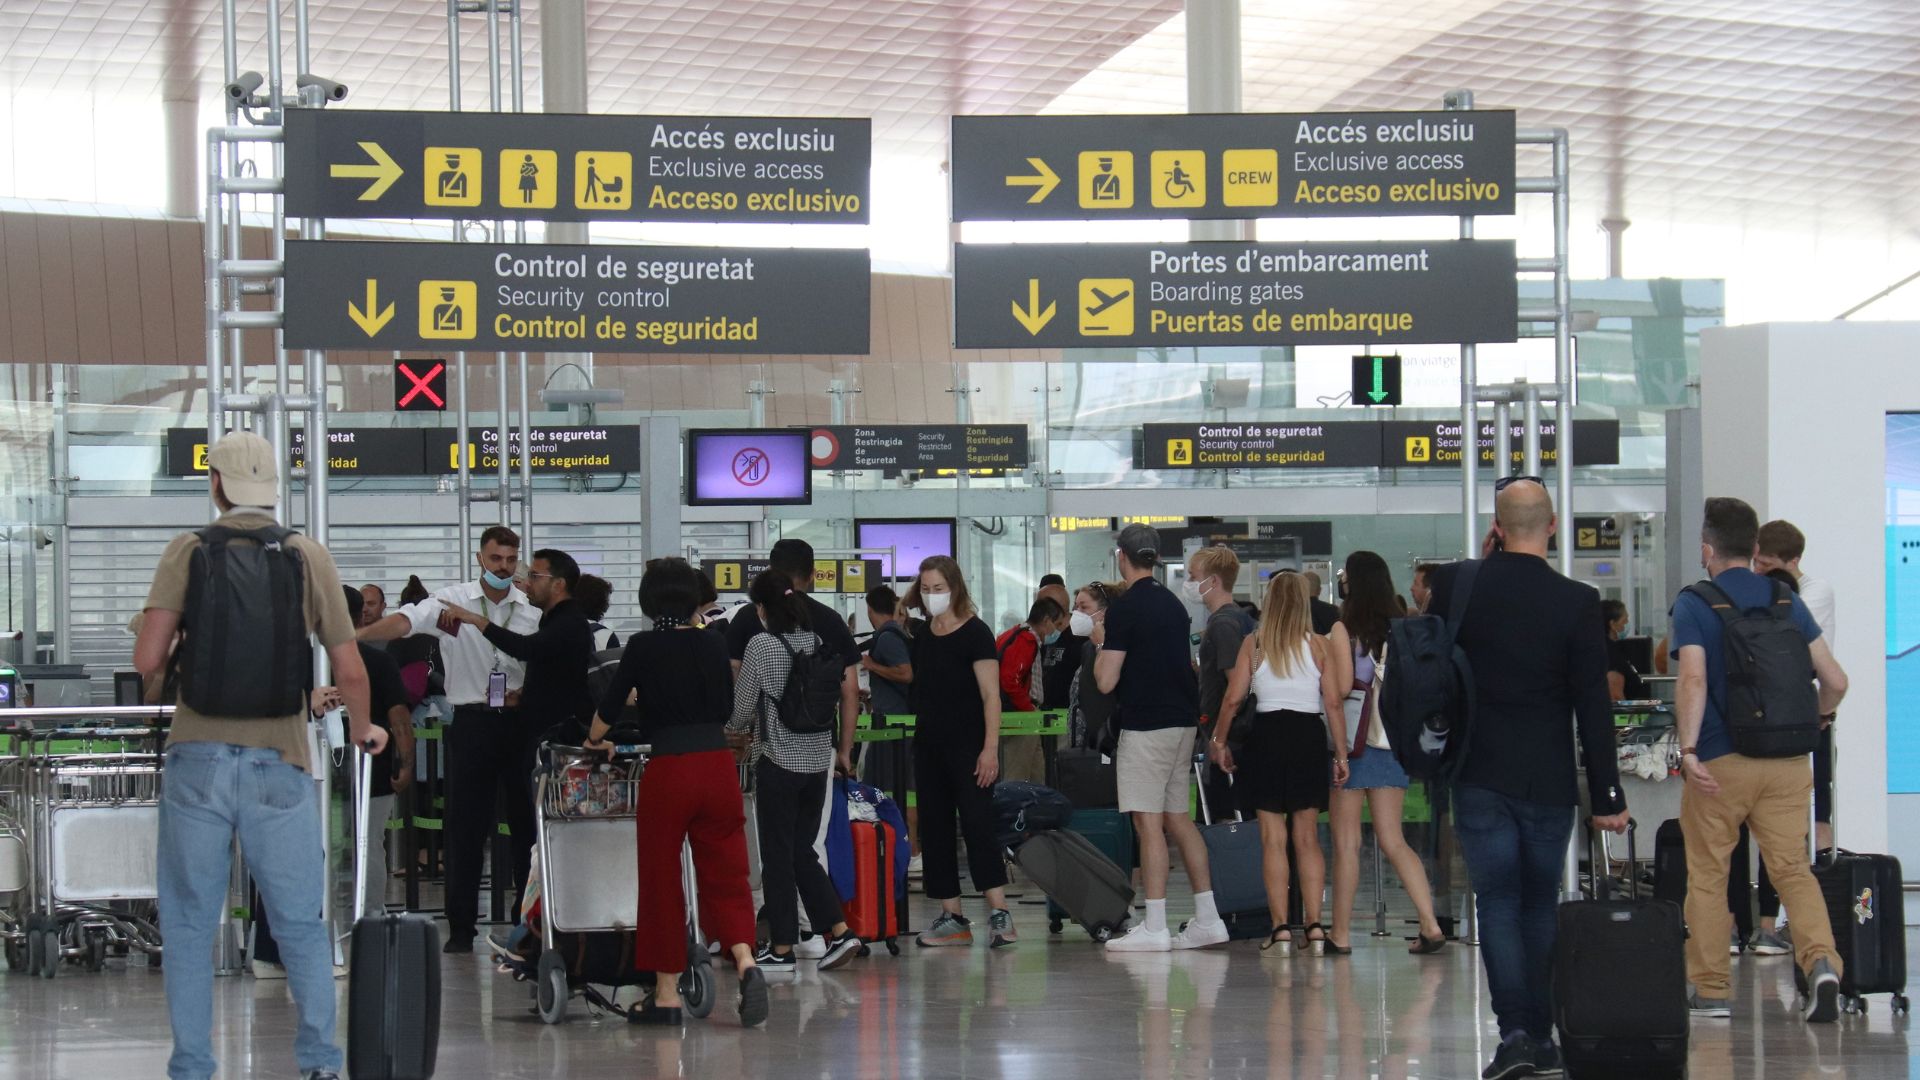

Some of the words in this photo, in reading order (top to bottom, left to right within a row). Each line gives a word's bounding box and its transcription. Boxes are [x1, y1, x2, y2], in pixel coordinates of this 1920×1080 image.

[650, 123, 725, 150] Accés
[734, 127, 836, 152] exclusiu
[1294, 118, 1368, 144] Accés
[1376, 118, 1474, 143] exclusiu
[649, 155, 746, 179] Exclusive
[754, 162, 824, 180] access
[1294, 151, 1389, 172] Exclusive
[1395, 153, 1465, 171] access
[1227, 171, 1272, 185] CREW
[1294, 180, 1381, 204] Acceso
[1389, 177, 1500, 202] exclusivo
[648, 185, 738, 211] Acceso
[746, 187, 861, 213] exclusivo
[1150, 250, 1227, 273] Portes
[1235, 249, 1429, 273] d'embarcament
[494, 253, 587, 278] Control
[596, 255, 627, 279] de
[636, 257, 755, 285] seguretat
[497, 285, 585, 311] Security
[597, 288, 670, 308] control
[1150, 281, 1243, 305] Boarding
[1249, 282, 1304, 305] gates
[1150, 309, 1244, 333] Puertas
[1252, 308, 1282, 332] de
[1290, 307, 1413, 337] embarque
[494, 313, 586, 339] Control
[595, 315, 627, 339] de
[635, 316, 758, 345] seguridad
[531, 431, 545, 441] de
[549, 430, 607, 442] seguretat
[855, 429, 875, 437] Zona
[918, 432, 945, 442] Security
[966, 428, 987, 436] Zona
[1199, 426, 1242, 437] Control
[1246, 425, 1261, 437] de
[1265, 425, 1323, 438] seguretat
[855, 438, 903, 447] Restringida
[918, 443, 952, 451] Restricted
[966, 436, 1014, 445] Restringida
[1200, 439, 1238, 450] Security
[1241, 439, 1275, 449] control
[530, 444, 557, 453] ontrol
[855, 447, 866, 455] de
[531, 456, 546, 466] de
[550, 454, 610, 467] seguridad
[855, 456, 897, 465] Seguretat
[967, 454, 1009, 463] Seguridad
[1199, 451, 1242, 462] Control
[1246, 450, 1261, 462] de
[1266, 450, 1325, 464] seguridad
